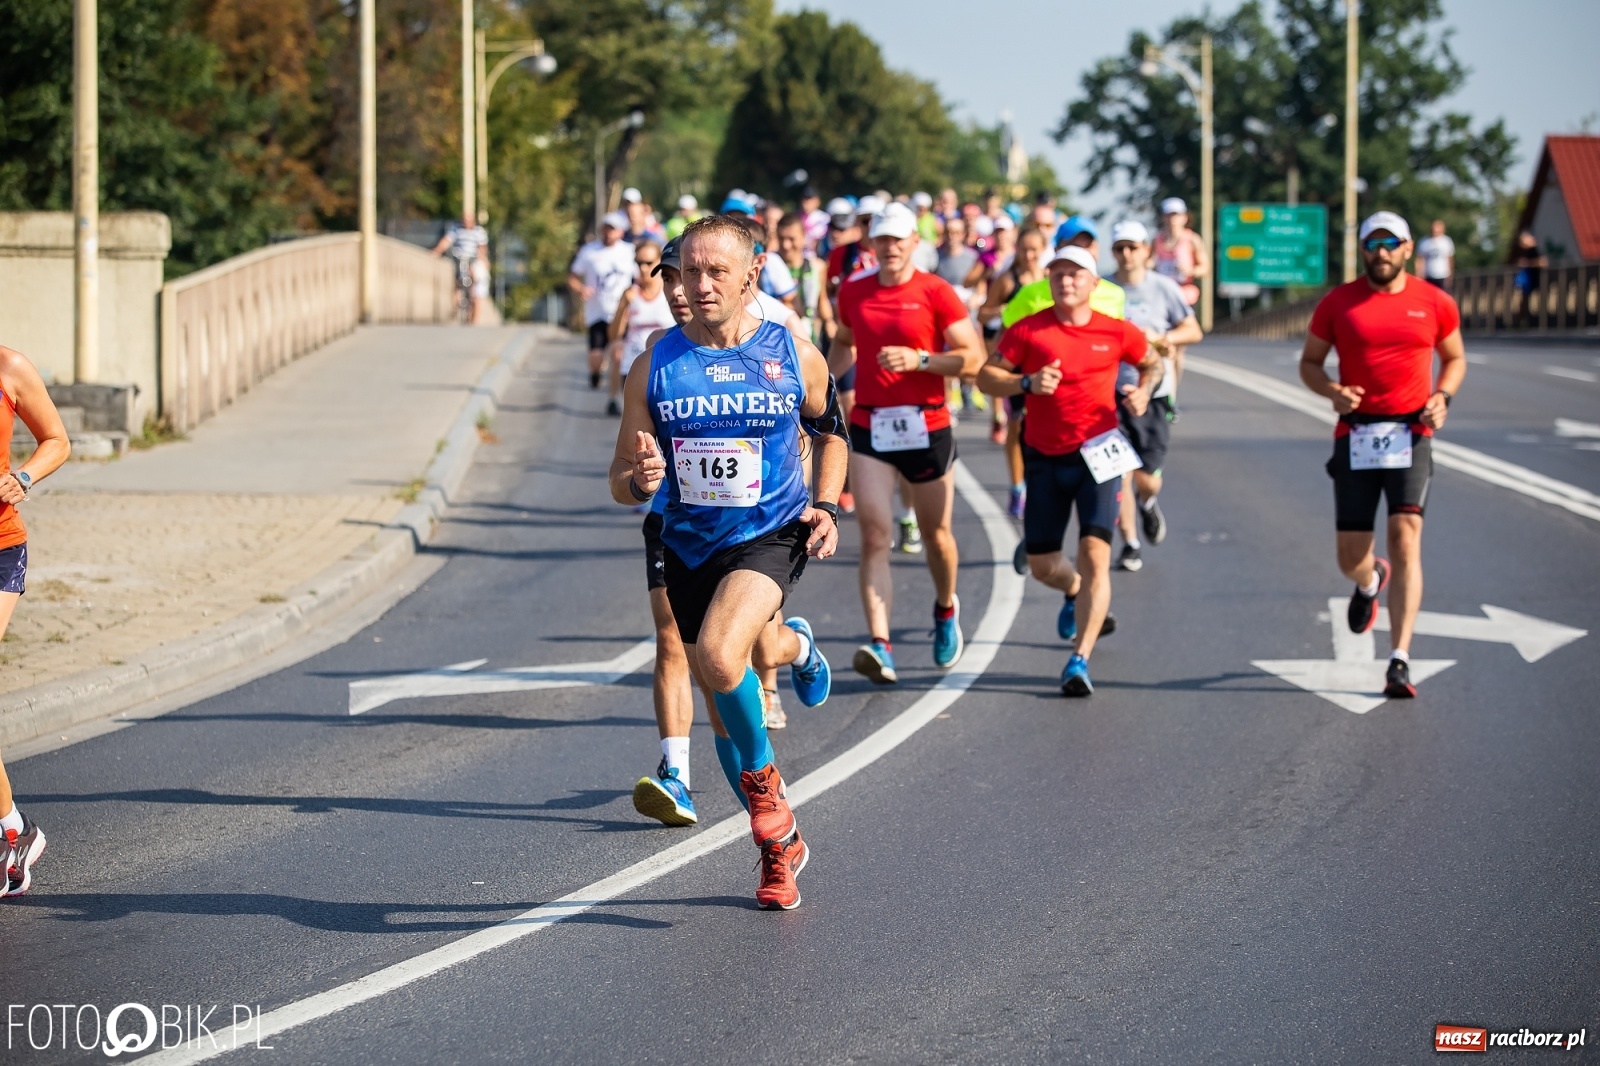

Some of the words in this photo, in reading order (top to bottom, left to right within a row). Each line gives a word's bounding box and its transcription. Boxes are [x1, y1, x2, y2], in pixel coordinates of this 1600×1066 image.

[713, 373, 746, 382] okna
[656, 392, 797, 422] RUNNERS
[745, 419, 776, 428] TEAM
[1372, 436, 1391, 450] 89
[699, 457, 739, 479] 163
